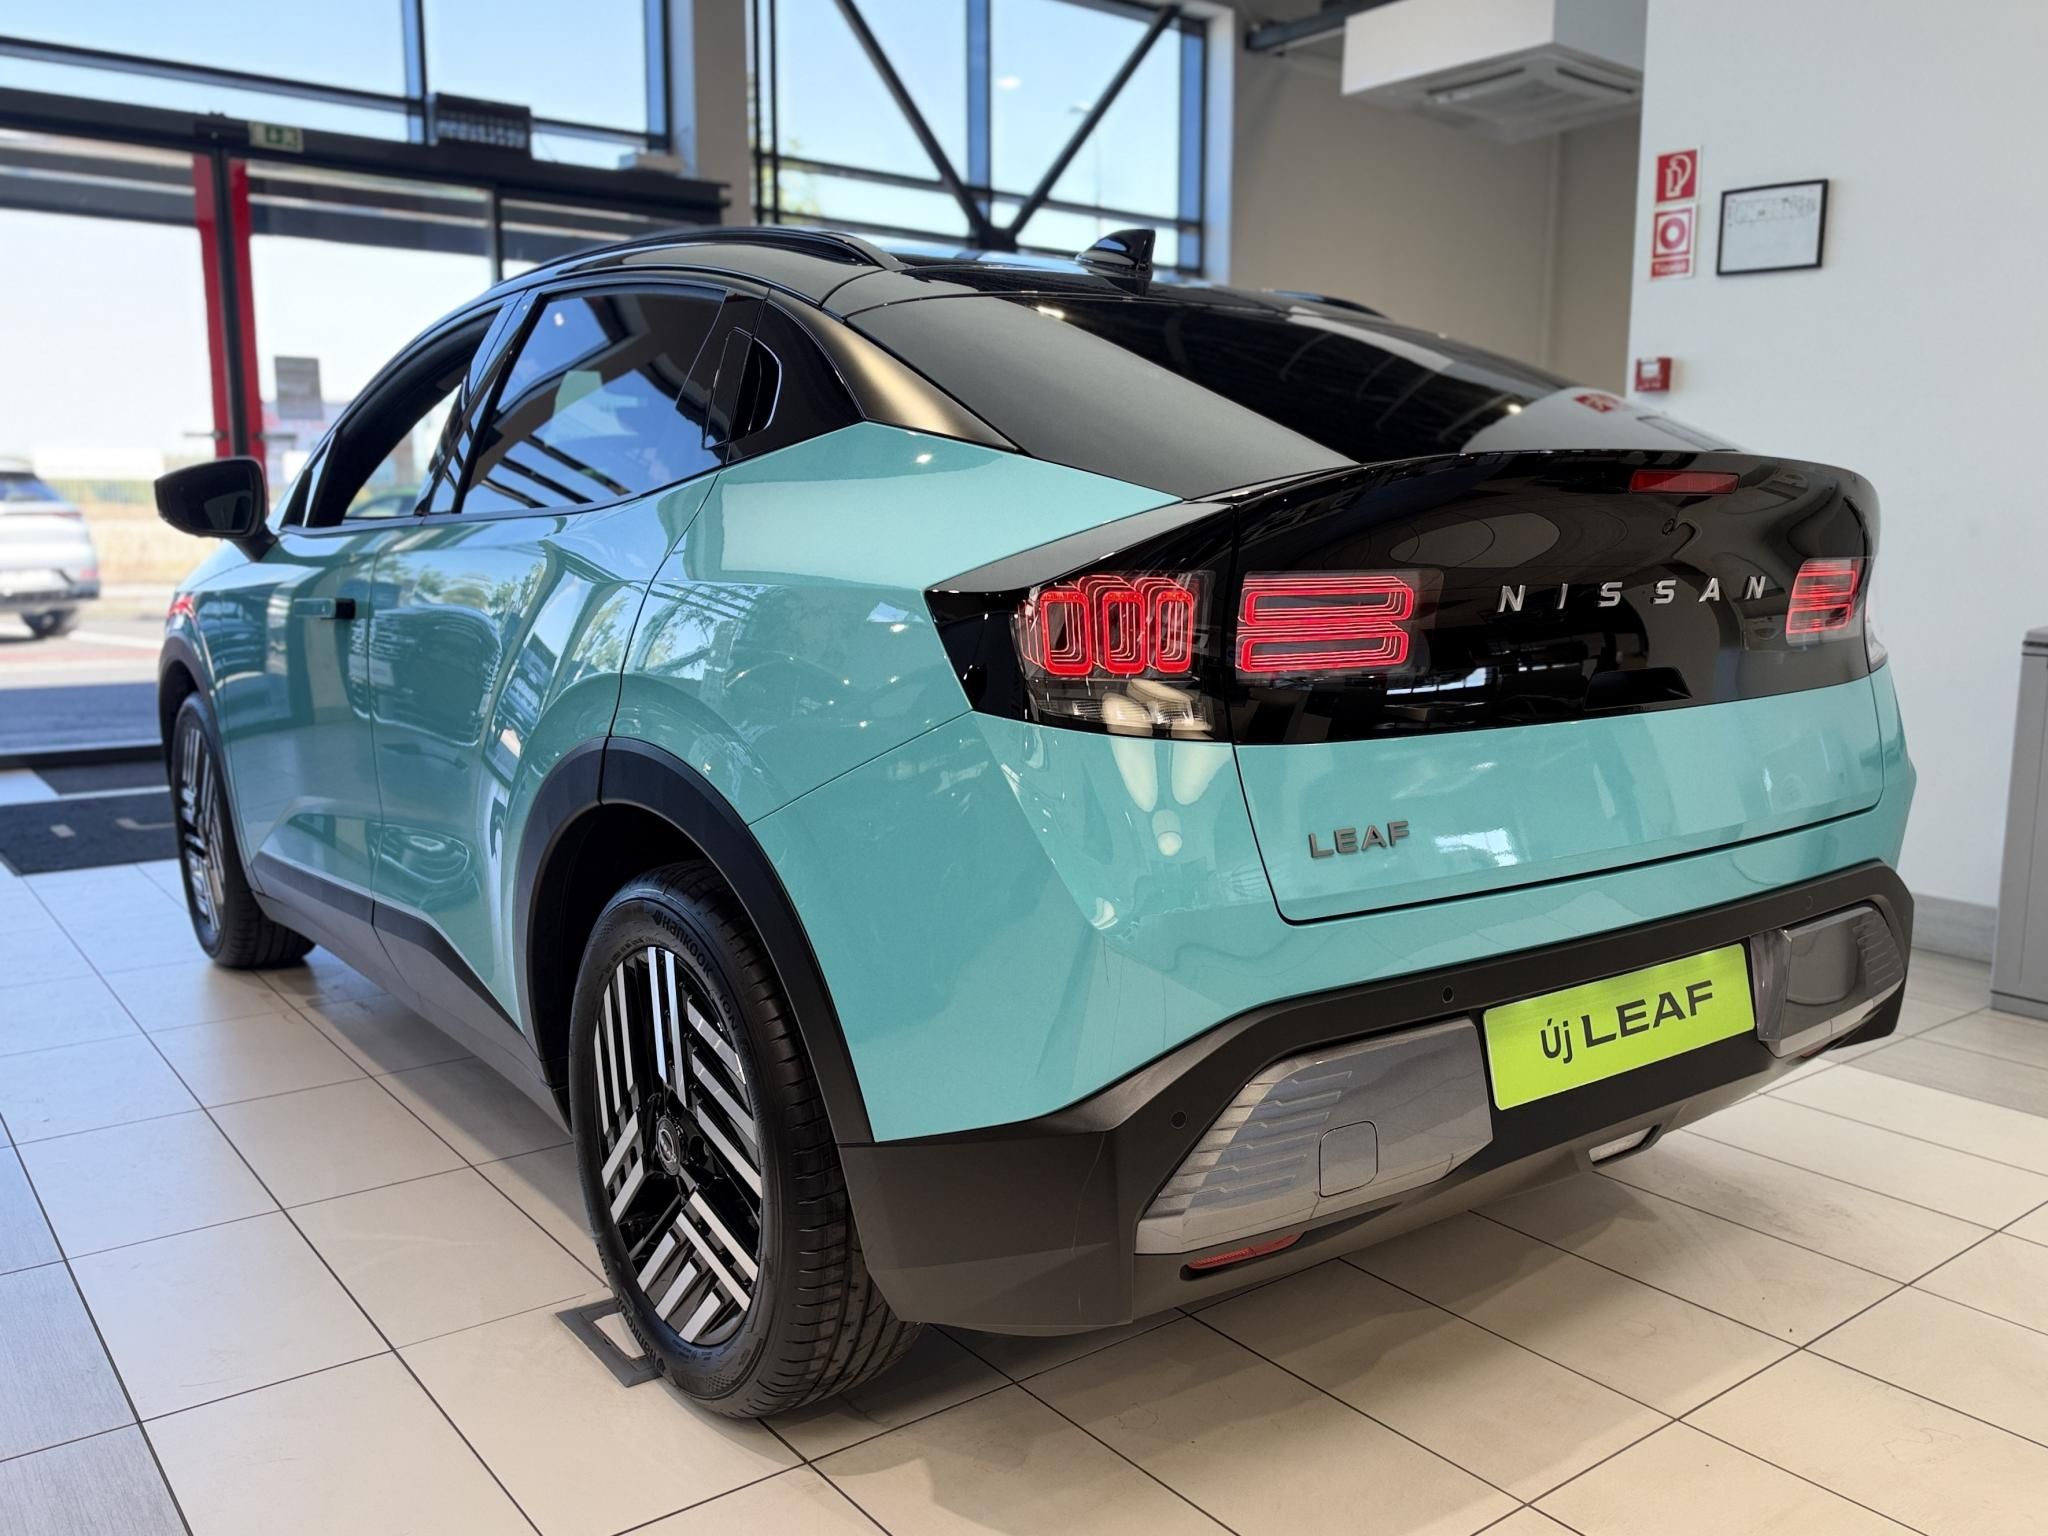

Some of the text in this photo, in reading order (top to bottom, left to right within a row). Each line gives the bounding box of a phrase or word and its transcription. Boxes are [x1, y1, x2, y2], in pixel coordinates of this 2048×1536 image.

[1497, 576, 1766, 613] NISSAN
[1308, 820, 1411, 858] LEAF
[1540, 980, 1713, 1064] Új LEAF
